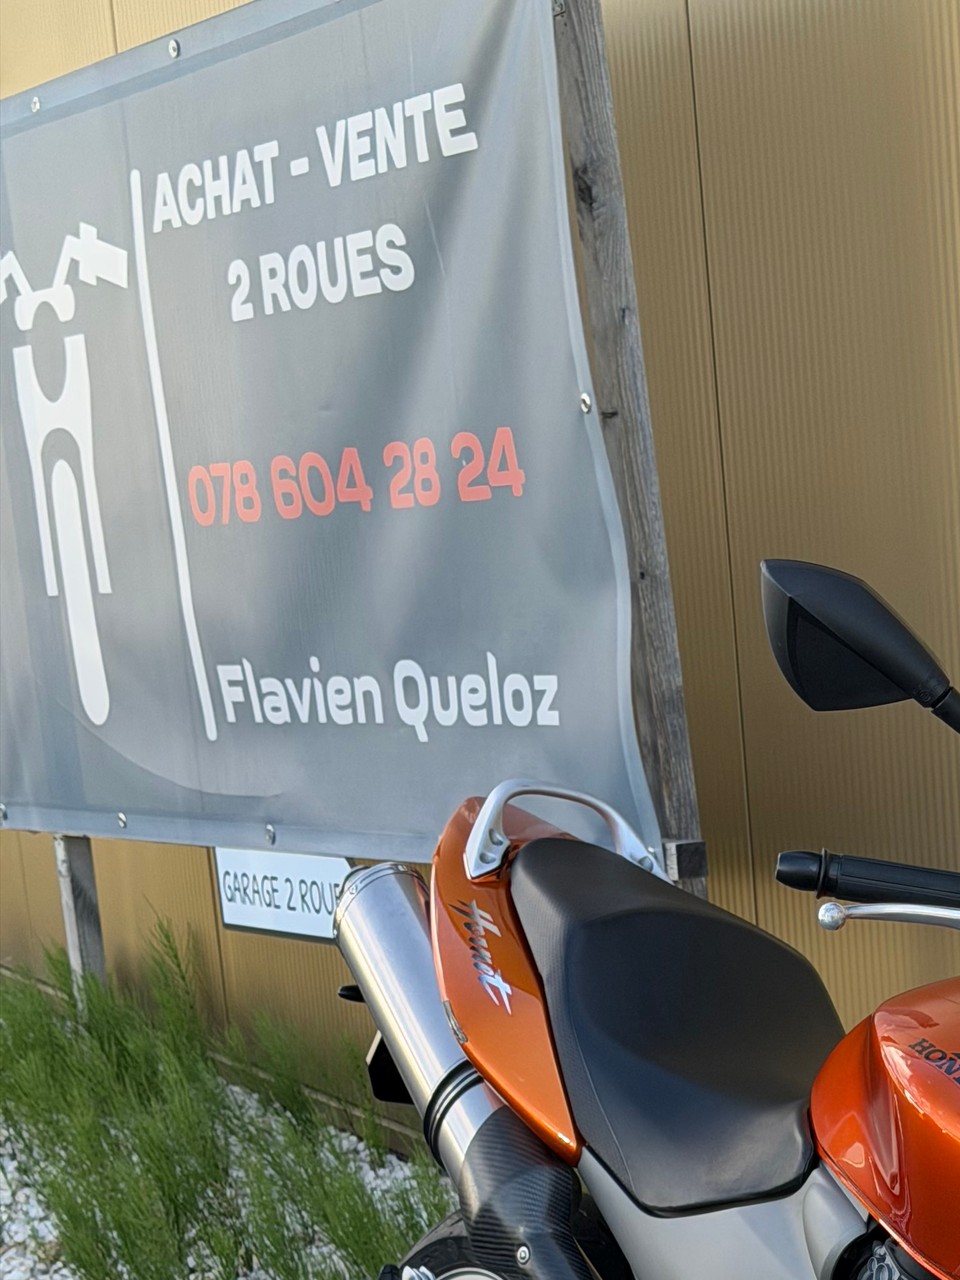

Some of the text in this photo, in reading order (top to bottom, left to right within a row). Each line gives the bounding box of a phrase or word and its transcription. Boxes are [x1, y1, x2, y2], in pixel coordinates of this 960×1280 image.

[153, 140, 279, 233] ACHAT
[315, 86, 478, 187] VENTE
[227, 223, 415, 322] 2 ROUES
[188, 426, 526, 527] 078 604 28 24
[216, 651, 560, 743] Flavien Queloz
[222, 870, 340, 916] GARAGE 2 ROUE
